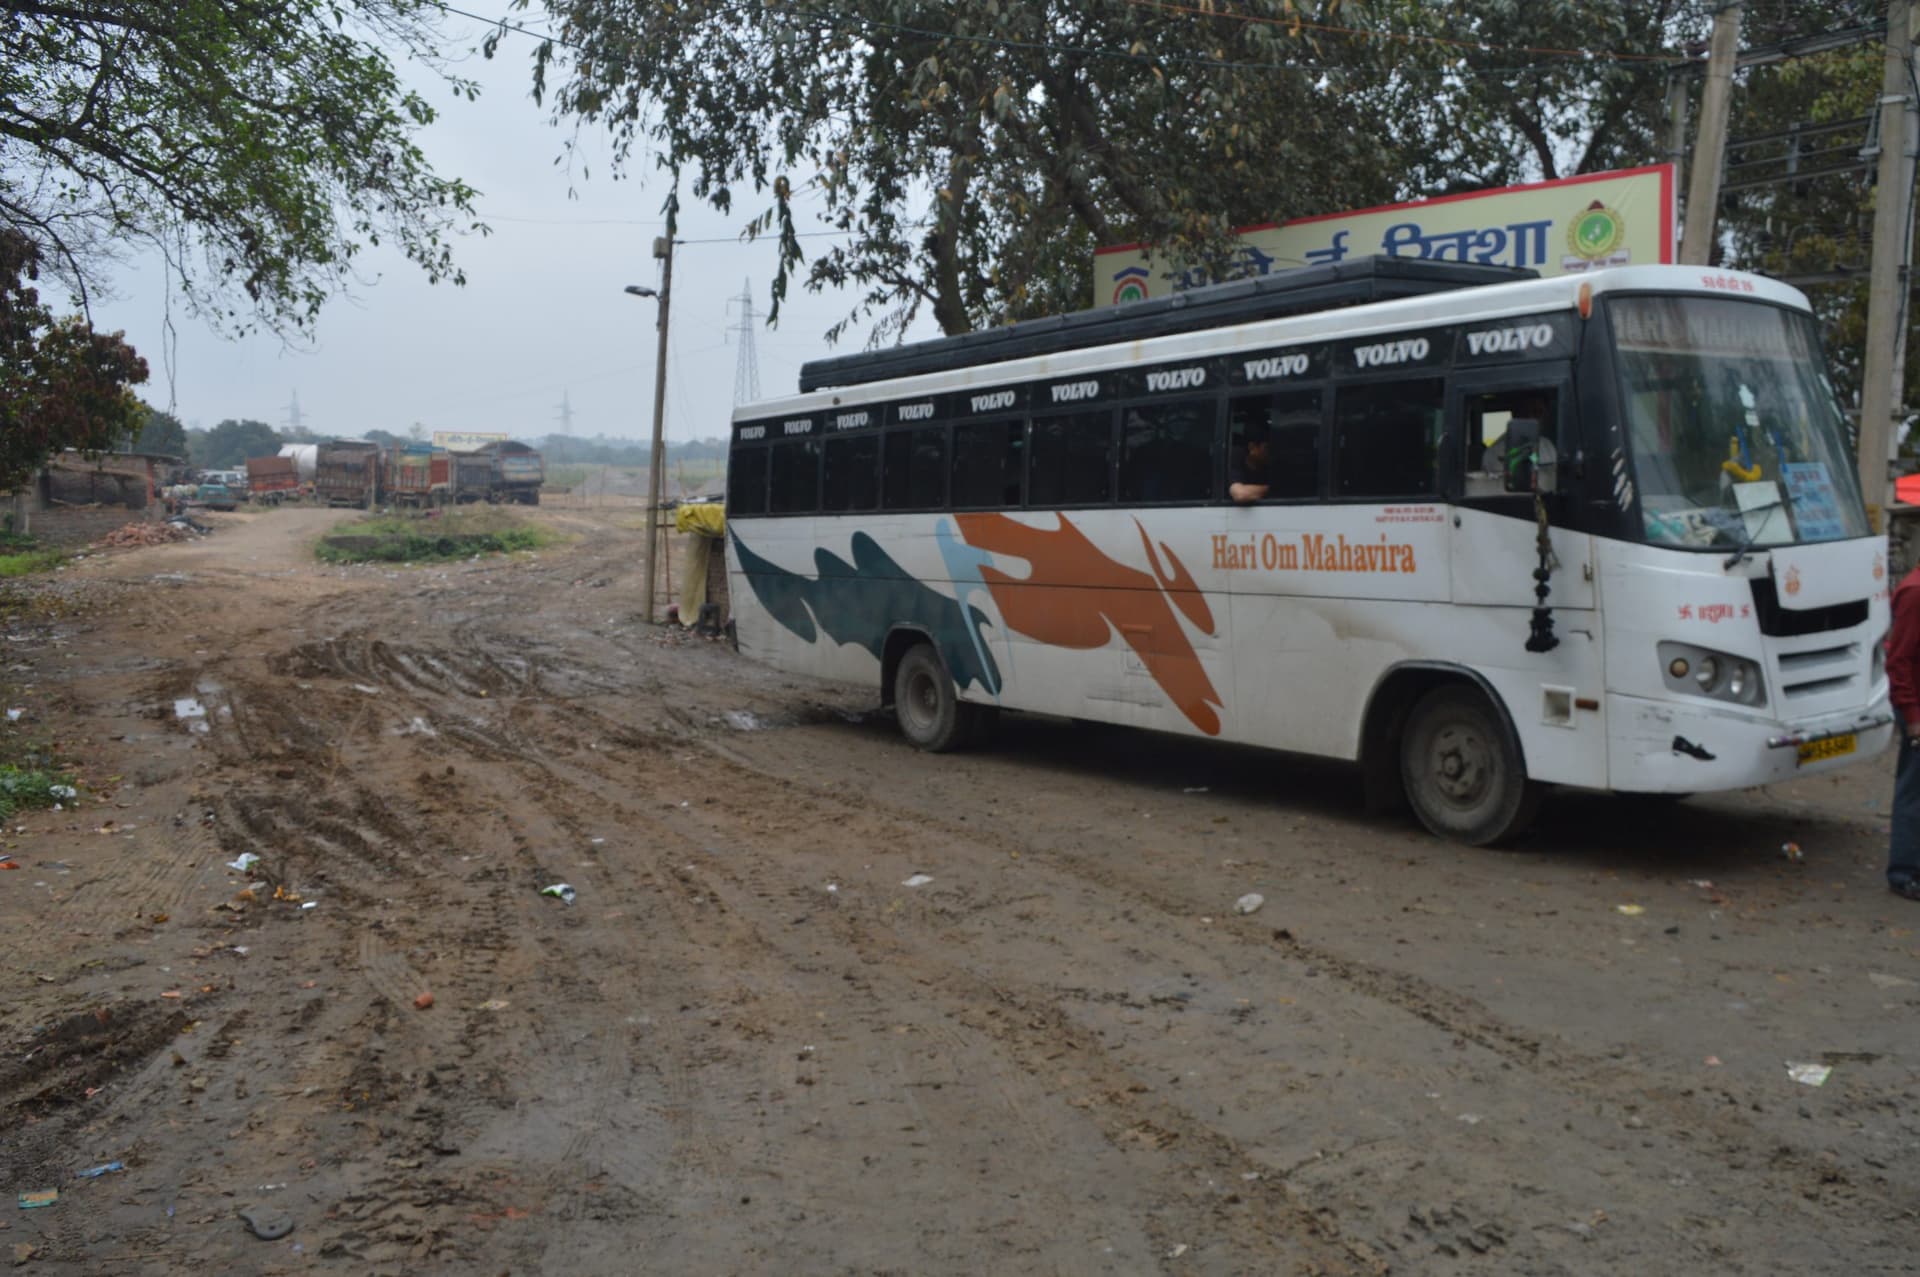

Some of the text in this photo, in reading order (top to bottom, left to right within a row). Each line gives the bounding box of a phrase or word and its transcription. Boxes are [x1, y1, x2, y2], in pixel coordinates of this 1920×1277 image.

[1468, 324, 1553, 354] VOLVO
[1354, 339, 1429, 367] VOLVO
[1244, 354, 1308, 380] VOLVO
[1147, 368, 1205, 391] VOLVO
[971, 391, 1015, 412] VOLVO
[1052, 381, 1098, 401] VOLVO
[837, 412, 868, 429] VOLVO
[899, 403, 934, 420] VOLVO
[784, 419, 812, 434] VOLVO
[1211, 532, 1417, 573] Hari Om Mahavira
